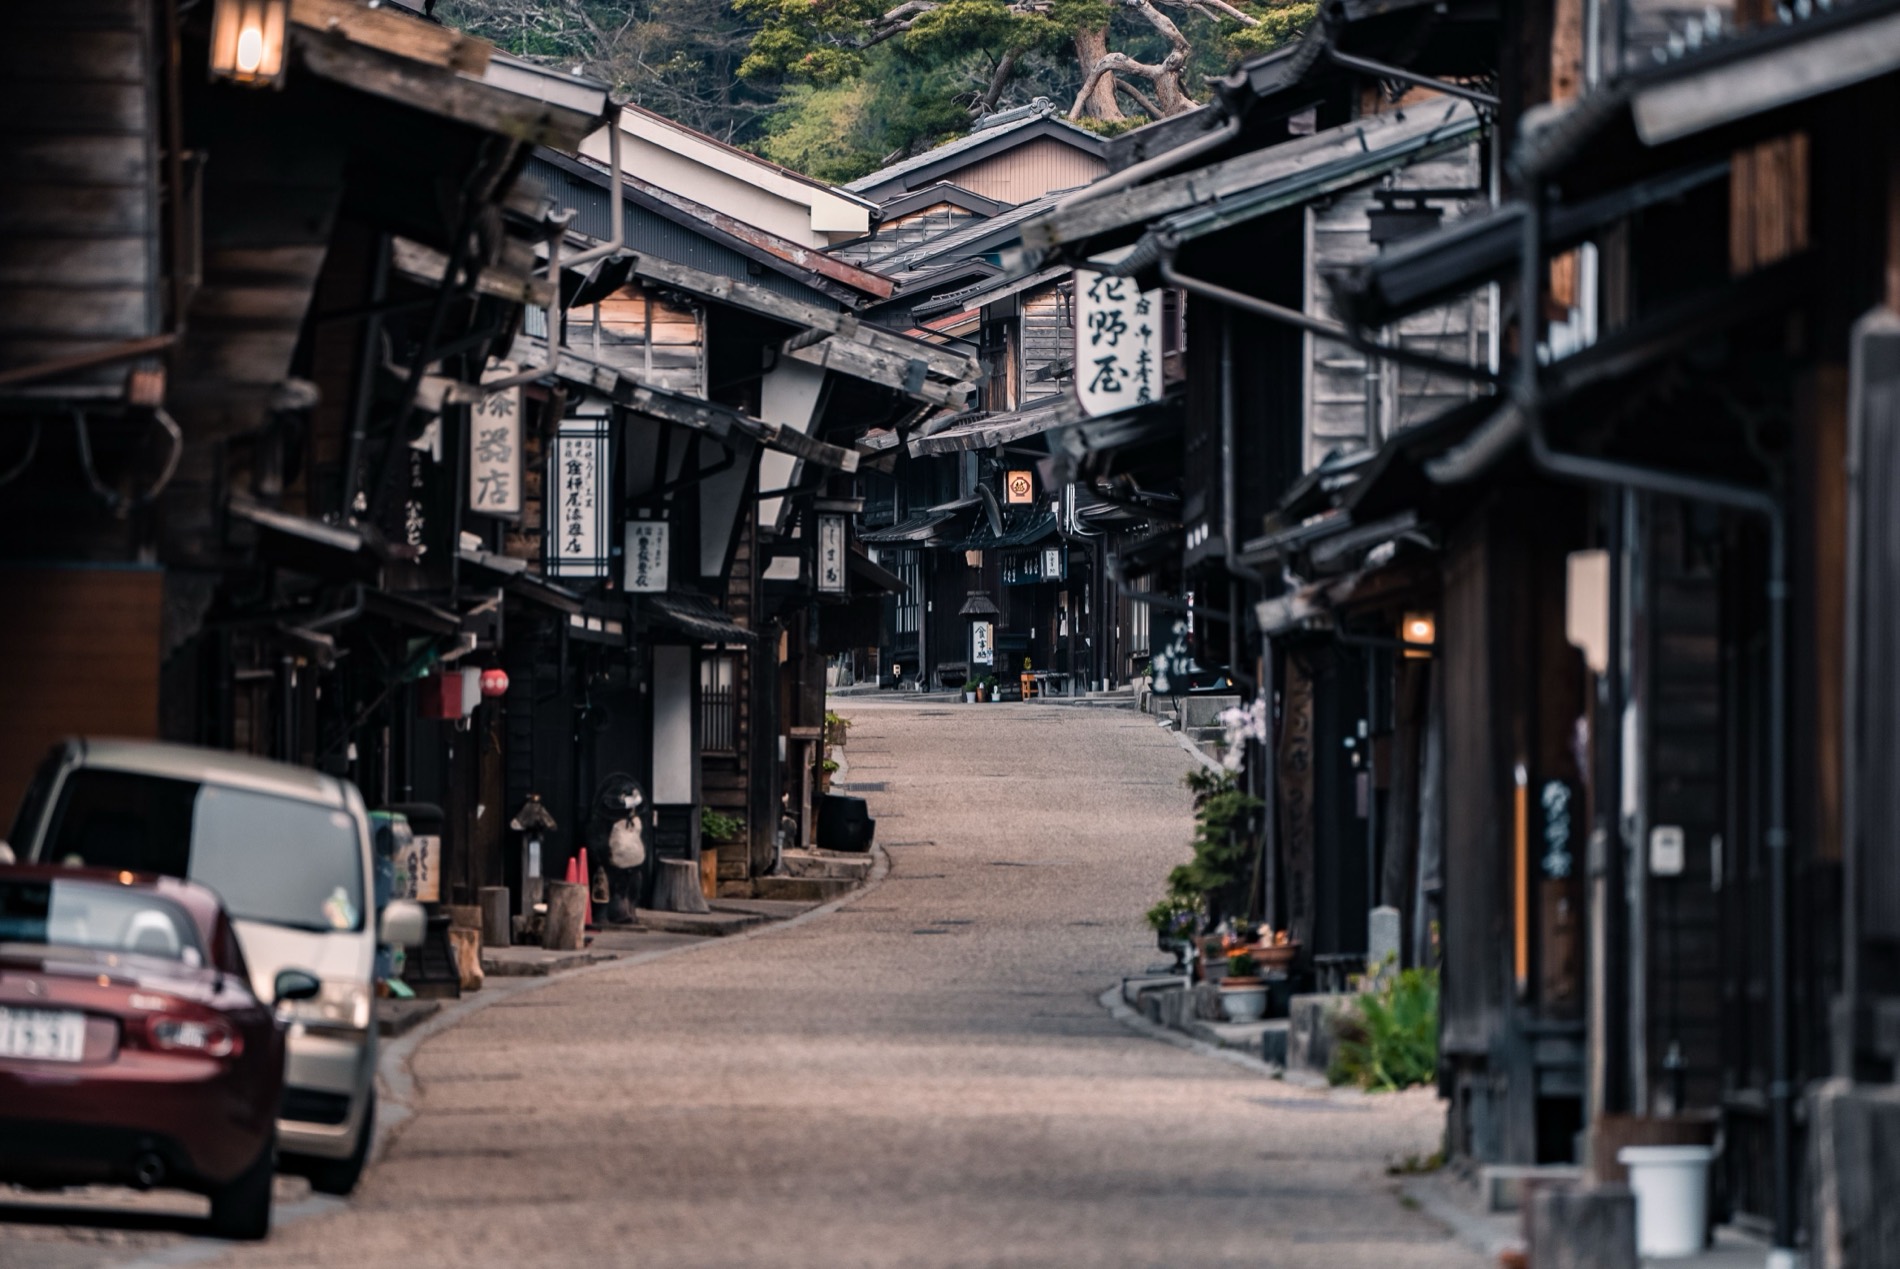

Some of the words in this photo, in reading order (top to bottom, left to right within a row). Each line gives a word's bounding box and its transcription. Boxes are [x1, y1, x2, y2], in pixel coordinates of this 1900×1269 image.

[1088, 275, 1129, 394] 花野屋
[975, 625, 987, 659] 食事処
